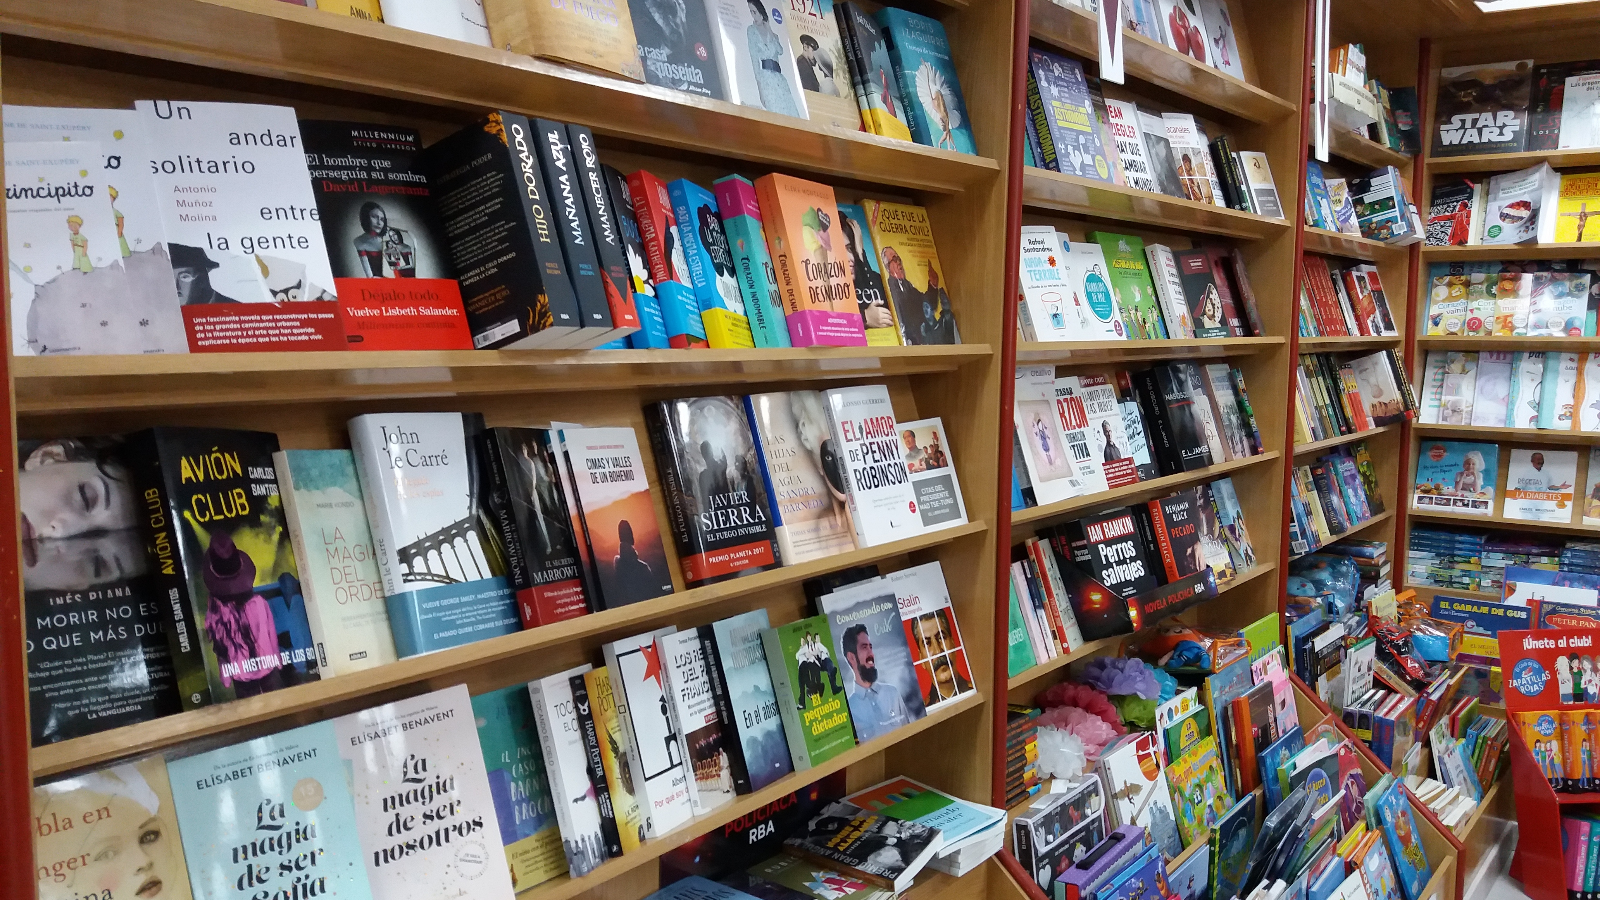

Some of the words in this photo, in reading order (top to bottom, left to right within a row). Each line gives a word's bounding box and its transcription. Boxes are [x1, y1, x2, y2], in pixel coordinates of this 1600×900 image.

[153, 100, 192, 120] Un
[1440, 110, 1521, 129] STAR
[229, 130, 297, 148] andar
[351, 130, 414, 142] MILLENNIUM
[1440, 126, 1520, 146] WARS
[548, 130, 568, 172] AZUL
[579, 133, 596, 168] ROJO
[150, 155, 256, 174] solitario
[305, 154, 320, 166] El
[322, 154, 368, 166] hombre
[371, 158, 392, 170] que
[511, 123, 540, 200] DORADO
[308, 167, 368, 180] perseguía
[370, 170, 384, 180] su
[388, 171, 427, 184] sombra
[173, 185, 218, 194] Antonio
[176, 199, 214, 208] Muñoz
[260, 204, 321, 222] entre
[558, 174, 584, 246] MAÑANA
[588, 172, 615, 246] AMANECER
[180, 214, 218, 223] Molina
[532, 204, 551, 244] HIJO
[207, 232, 230, 251] la
[240, 232, 310, 255] gente
[800, 256, 847, 282] CORAZÓN
[1027, 269, 1062, 282] TERRIBLE
[740, 254, 757, 290] CORAZÓN
[750, 288, 767, 331] INDOMABLE
[808, 282, 851, 304] DESNUDO
[346, 306, 380, 317] Vuelve
[382, 306, 418, 316] Lisbeth
[419, 306, 460, 316] Salander.
[1552, 304, 1573, 312] nube
[380, 426, 421, 451] John
[841, 420, 860, 442] EL
[864, 416, 894, 440] AMOR
[766, 435, 786, 446] LAS
[386, 450, 404, 470] le
[406, 448, 450, 468] Carré
[770, 448, 797, 460] HIJAS
[850, 450, 861, 462] DE
[862, 438, 901, 466] PENNY
[180, 446, 242, 485] AVIÓN
[248, 466, 274, 480] CARLOS
[586, 458, 606, 470] CIMAS
[606, 458, 611, 470] Y
[610, 456, 632, 468] VALLES
[774, 463, 793, 474] DEL
[590, 472, 599, 484] DE
[599, 472, 609, 483] UN
[610, 470, 634, 483] BOHEMIO
[778, 476, 803, 488] AGUA
[854, 462, 910, 492] ROBINSON
[251, 483, 278, 496] SANTOS
[780, 486, 816, 500] SANDRA
[920, 485, 936, 494] CITAS
[936, 484, 944, 492] DEL
[920, 490, 950, 502] PRESIDENTE
[144, 488, 166, 529] CLUB
[191, 488, 250, 522] CLUB
[709, 490, 750, 512] JAVIER
[784, 500, 825, 514] BARNEDA
[700, 504, 766, 532] SIERRA
[322, 526, 346, 546] LA
[707, 534, 716, 542] EL
[716, 530, 738, 540] FUEGO
[738, 524, 767, 536] INVISIBLE
[1087, 523, 1104, 542] IAN
[1103, 516, 1135, 538] RANKIN
[1170, 523, 1196, 538] PECADO
[148, 528, 176, 576] AVIÓN
[499, 508, 523, 586] MARROWBONE
[709, 554, 730, 564] PREMIO
[730, 550, 752, 560] PLANETA
[753, 546, 764, 555] 2017
[1098, 540, 1136, 564] Perros
[330, 564, 366, 586] DEL
[1102, 558, 1145, 586] salvajes
[50, 592, 82, 606] INÉS
[168, 587, 184, 622] SANTOS
[897, 594, 920, 610] Stalin
[1144, 598, 1167, 614] NOVELA
[1194, 582, 1206, 594] RBA
[36, 610, 98, 630] MORIR
[106, 606, 132, 620] NO
[140, 602, 158, 616] ES
[1439, 601, 1450, 609] EL
[1453, 604, 1489, 614] GARAJE
[1490, 608, 1504, 616] DE
[1506, 610, 1528, 618] GUS
[1552, 617, 1578, 626] PETER
[1579, 619, 1597, 628] PAN
[176, 621, 190, 653] CARLOS
[1522, 635, 1556, 650] ¡Únete
[1558, 637, 1567, 648] al
[1569, 636, 1592, 648] club!
[221, 660, 241, 678] UNA
[242, 651, 281, 673] HISTORIA
[281, 650, 292, 665] DE
[292, 650, 304, 664] LOS
[305, 648, 316, 661] 80
[674, 654, 692, 669] LOS
[682, 668, 698, 684] DEL
[1508, 670, 1551, 688] ZAPATILLAS
[1520, 682, 1544, 694] ROJAS
[812, 693, 822, 707] El
[98, 704, 142, 718] VANGUARDIA
[804, 698, 841, 726] pequeño
[350, 725, 398, 747] ELÍSABET
[401, 708, 455, 732] BENAVENT
[584, 720, 597, 746] HARRY
[811, 712, 848, 736] dictador
[196, 766, 254, 790] ELÍSABET
[256, 748, 318, 774] BENAVENT
[402, 754, 428, 784] La
[512, 760, 536, 778] CASO
[590, 746, 605, 779] POTTER
[382, 774, 456, 813] magia
[654, 798, 664, 808] Por
[664, 792, 676, 806] qué
[676, 789, 686, 801] soy
[255, 798, 286, 831] La
[386, 812, 416, 838] de
[422, 799, 462, 826] ser
[232, 821, 317, 865] magia
[373, 816, 484, 868] nosotros
[748, 823, 775, 845] RBA
[236, 864, 272, 892] de
[278, 848, 324, 878] ser
